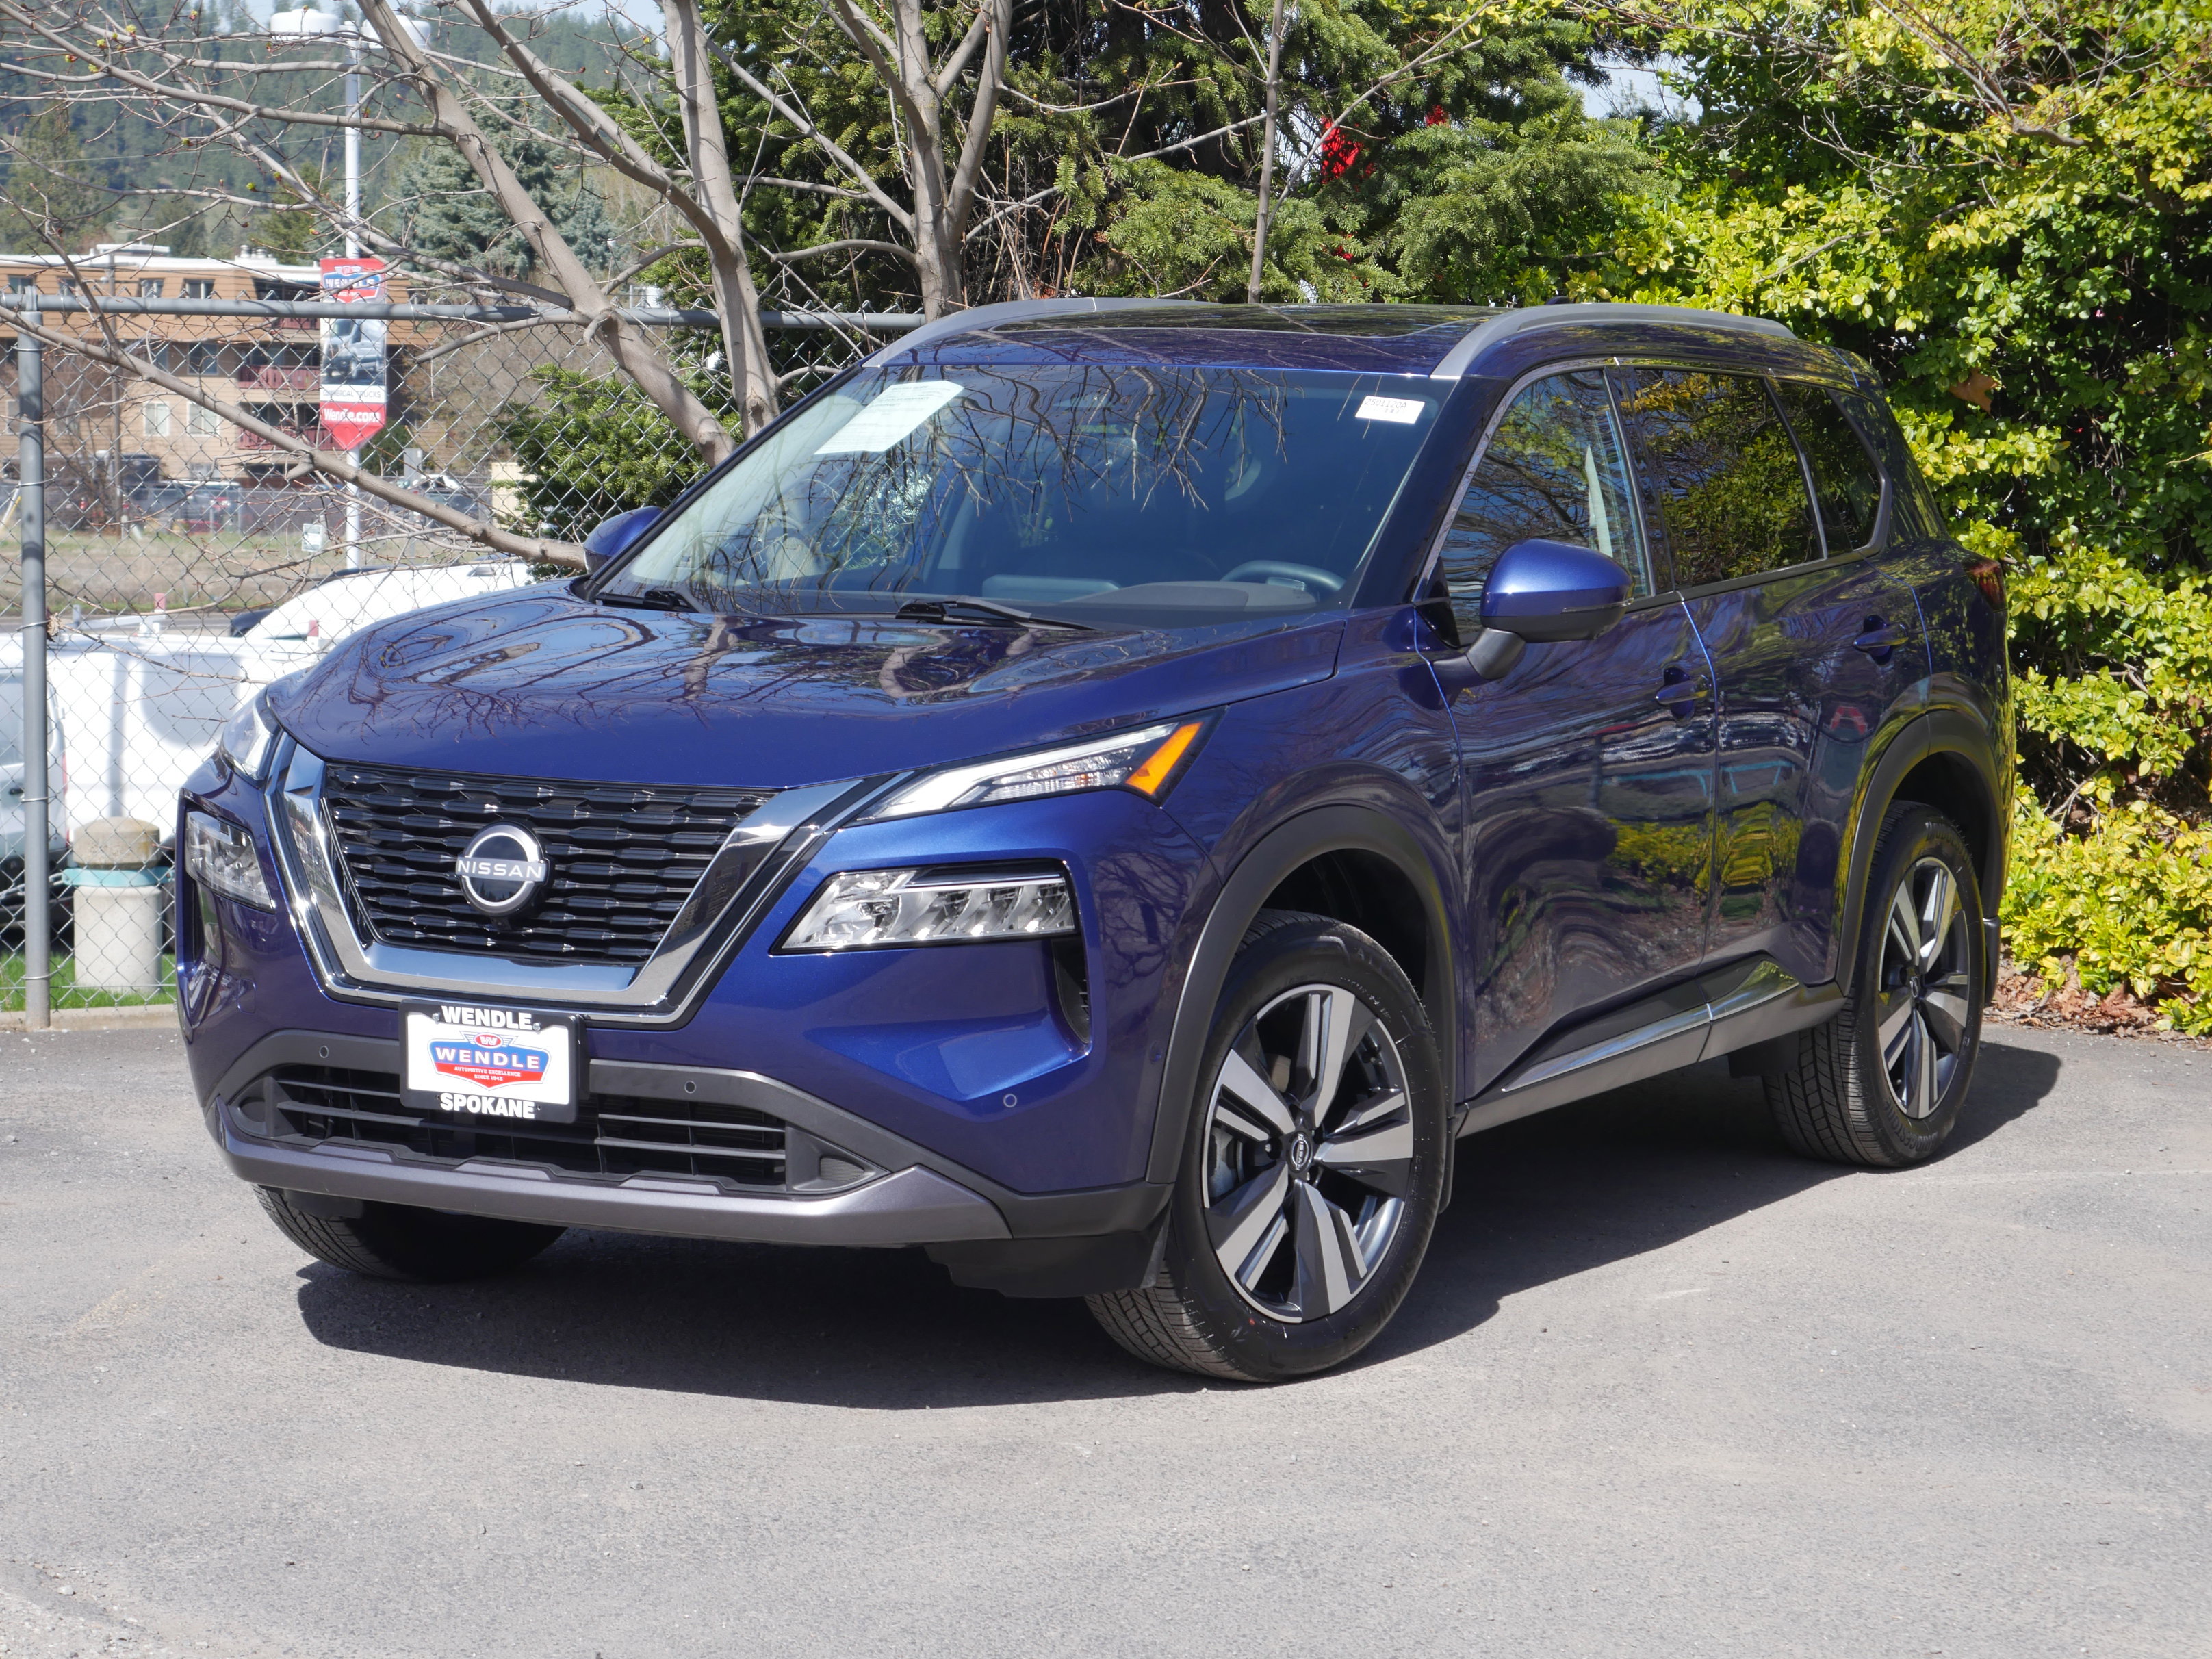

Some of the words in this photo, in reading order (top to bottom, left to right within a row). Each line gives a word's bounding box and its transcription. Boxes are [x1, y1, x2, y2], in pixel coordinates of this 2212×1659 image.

[457, 860, 543, 879] NISSAN
[441, 1005, 534, 1030] WENDLE
[435, 1046, 540, 1070] WENDLE
[488, 1069, 521, 1077] EXCELLENCE
[440, 1092, 535, 1119] SPOKANE
